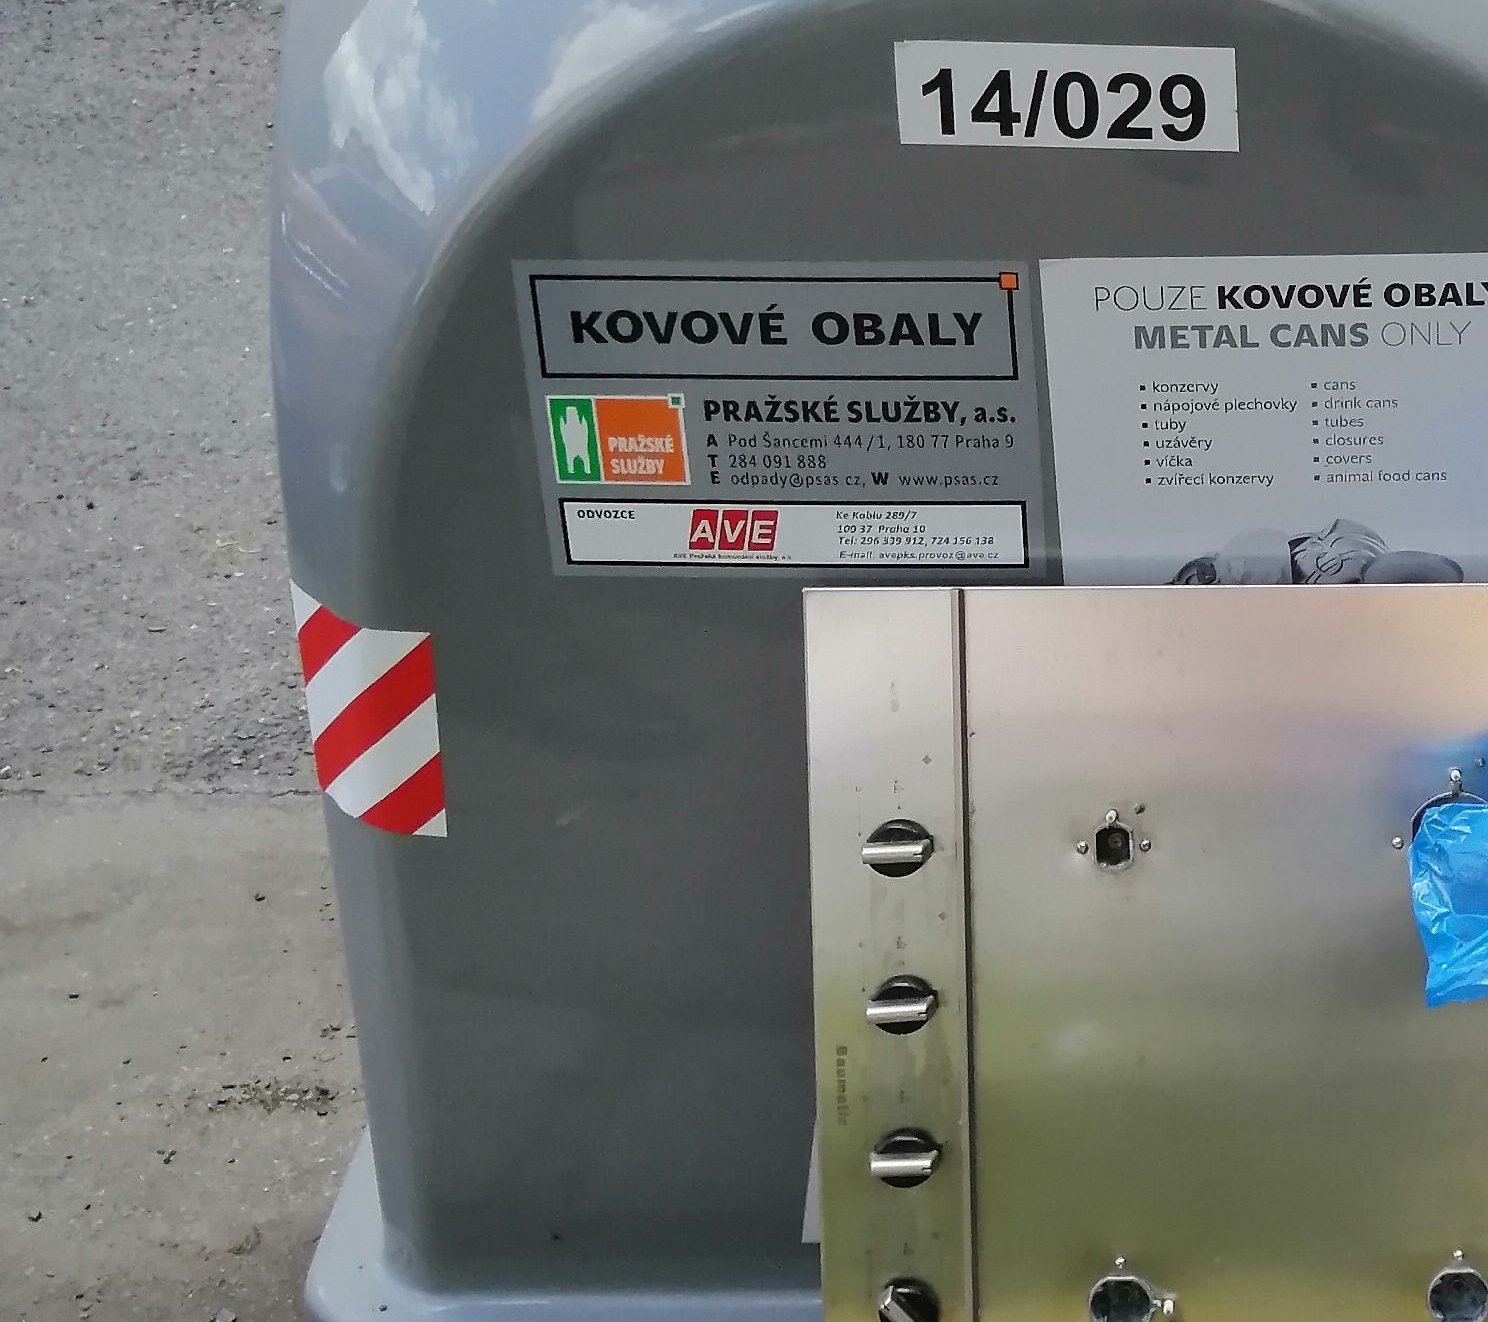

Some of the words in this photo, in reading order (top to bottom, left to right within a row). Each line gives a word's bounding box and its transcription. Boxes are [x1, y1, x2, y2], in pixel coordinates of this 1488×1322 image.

[920, 67, 1207, 141] 14/029
[1094, 285, 1208, 311] POUZE
[1217, 277, 1373, 309] KOVOVÉ
[569, 303, 788, 345] KOVOVÉ
[811, 311, 983, 347] OBALY
[1133, 325, 1260, 349] METAL
[1269, 322, 1370, 348] CANS
[1381, 321, 1472, 346] ONLY
[1152, 381, 1219, 395] konzervy
[1323, 380, 1356, 391] cans
[703, 394, 841, 423] PRAŽSKÉ
[846, 394, 967, 426] SLUŽBY,
[973, 405, 1016, 423] a.s.
[1153, 399, 1220, 414] nápojové
[1224, 397, 1298, 413] plechovky
[1324, 396, 1362, 409] drink
[1365, 398, 1398, 408] cans
[1154, 418, 1187, 433] tuby
[1325, 415, 1364, 428] tubes
[607, 434, 675, 453] PRAŽSKÉ
[706, 433, 718, 447] A
[728, 434, 757, 448] Pod
[763, 431, 828, 448] Šancemi
[897, 434, 925, 448] 180
[931, 434, 949, 448] 77
[955, 434, 1000, 448] Praha
[1005, 433, 1014, 448] 9
[1155, 436, 1213, 451] uzávěry
[1325, 434, 1384, 446] closures
[610, 456, 665, 475] SLUŽBY
[707, 454, 718, 468] T
[728, 454, 757, 468] 284
[762, 455, 792, 469] 091
[797, 454, 827, 469] 888
[1156, 455, 1193, 467] víčka
[1325, 454, 1372, 464] covers
[710, 471, 721, 484] E
[730, 472, 866, 488] odpady@psascz,
[871, 471, 890, 485] W
[899, 475, 999, 489] www.psas.cz
[1157, 473, 1205, 486] zvířecí
[1208, 473, 1274, 487] konzervy
[1326, 470, 1373, 483] animal
[1378, 470, 1411, 482] food
[1415, 472, 1448, 481] cans
[576, 509, 636, 519] ODVOZCE
[852, 511, 882, 520] Kablu
[689, 519, 775, 544] AVE
[878, 525, 910, 534] Praha
